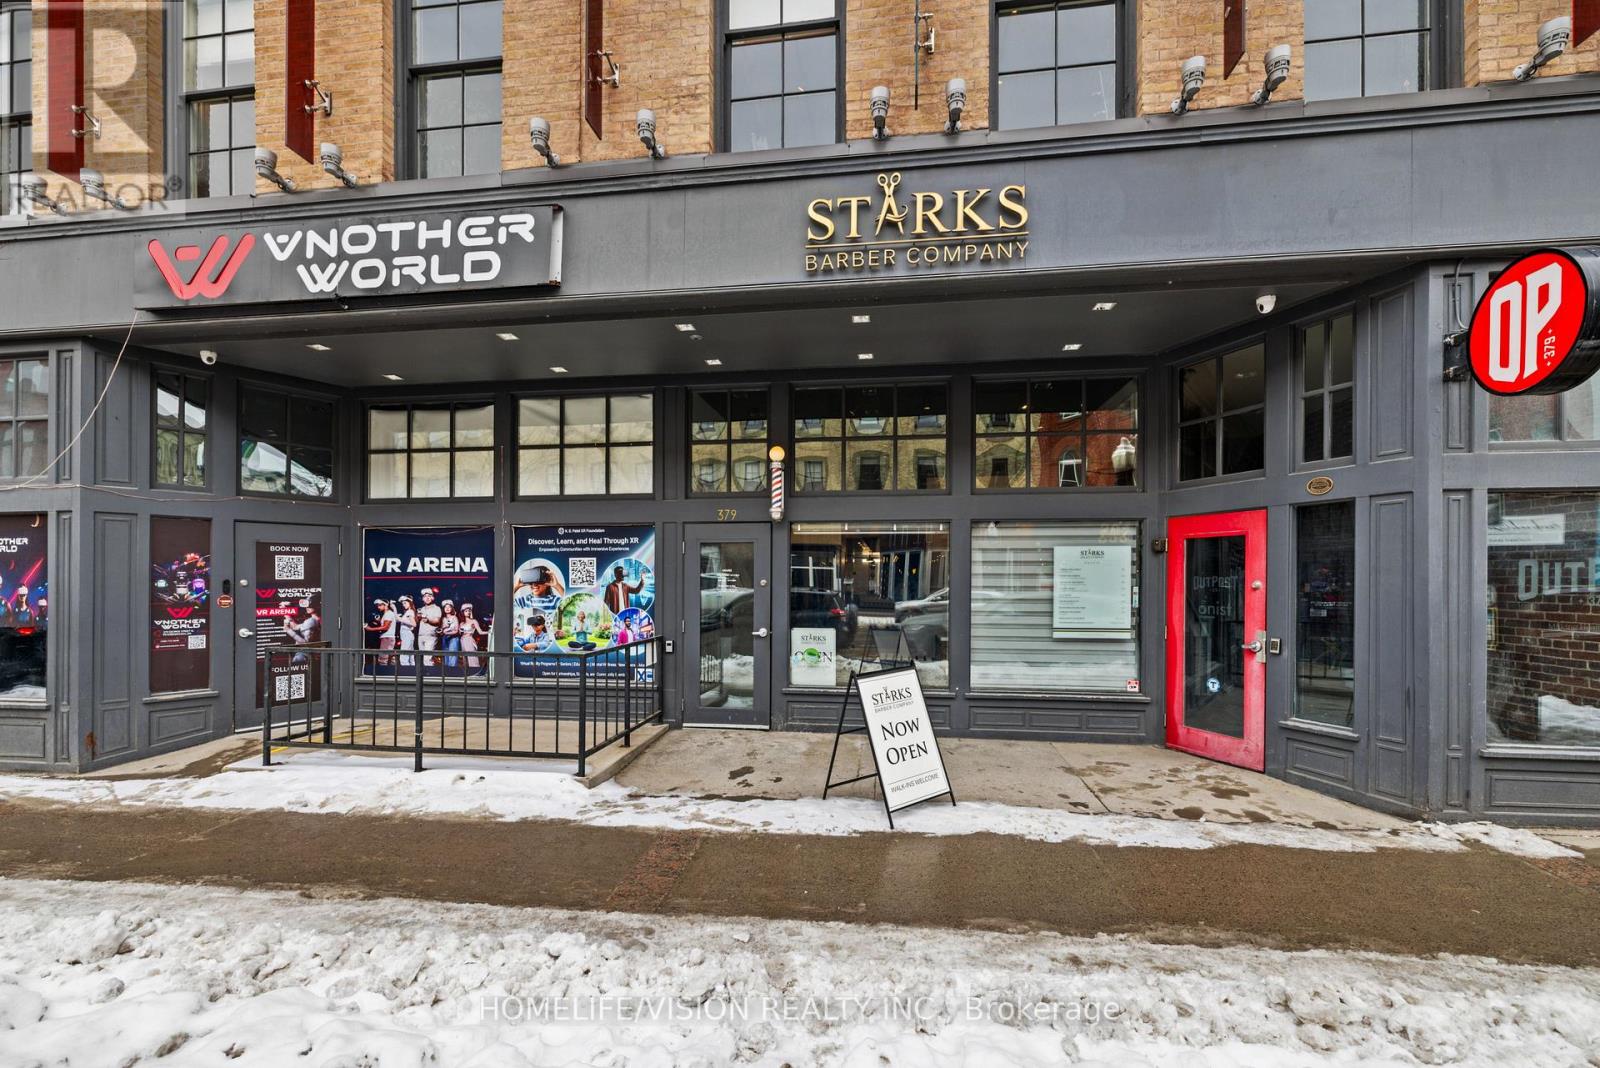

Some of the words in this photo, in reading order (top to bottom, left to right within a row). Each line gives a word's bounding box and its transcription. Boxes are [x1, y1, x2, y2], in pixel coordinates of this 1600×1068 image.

[806, 171, 1030, 242] STARKS
[805, 248, 896, 272] BARBER
[906, 241, 1030, 265] COMPANY
[296, 250, 502, 294] WORLD
[1488, 261, 1563, 383] OP
[1543, 335, 1556, 360] 379
[716, 509, 737, 521] 379
[291, 545, 310, 553] NOW
[588, 537, 603, 545] Heal
[603, 537, 629, 546] Through
[629, 536, 640, 544] XR
[369, 557, 402, 573] VR
[406, 556, 489, 573] ARENA
[800, 633, 827, 642] STARKS
[871, 685, 913, 706] STARKS
[890, 780, 915, 793] WALK-INS
[914, 773, 940, 785] WELCOME
